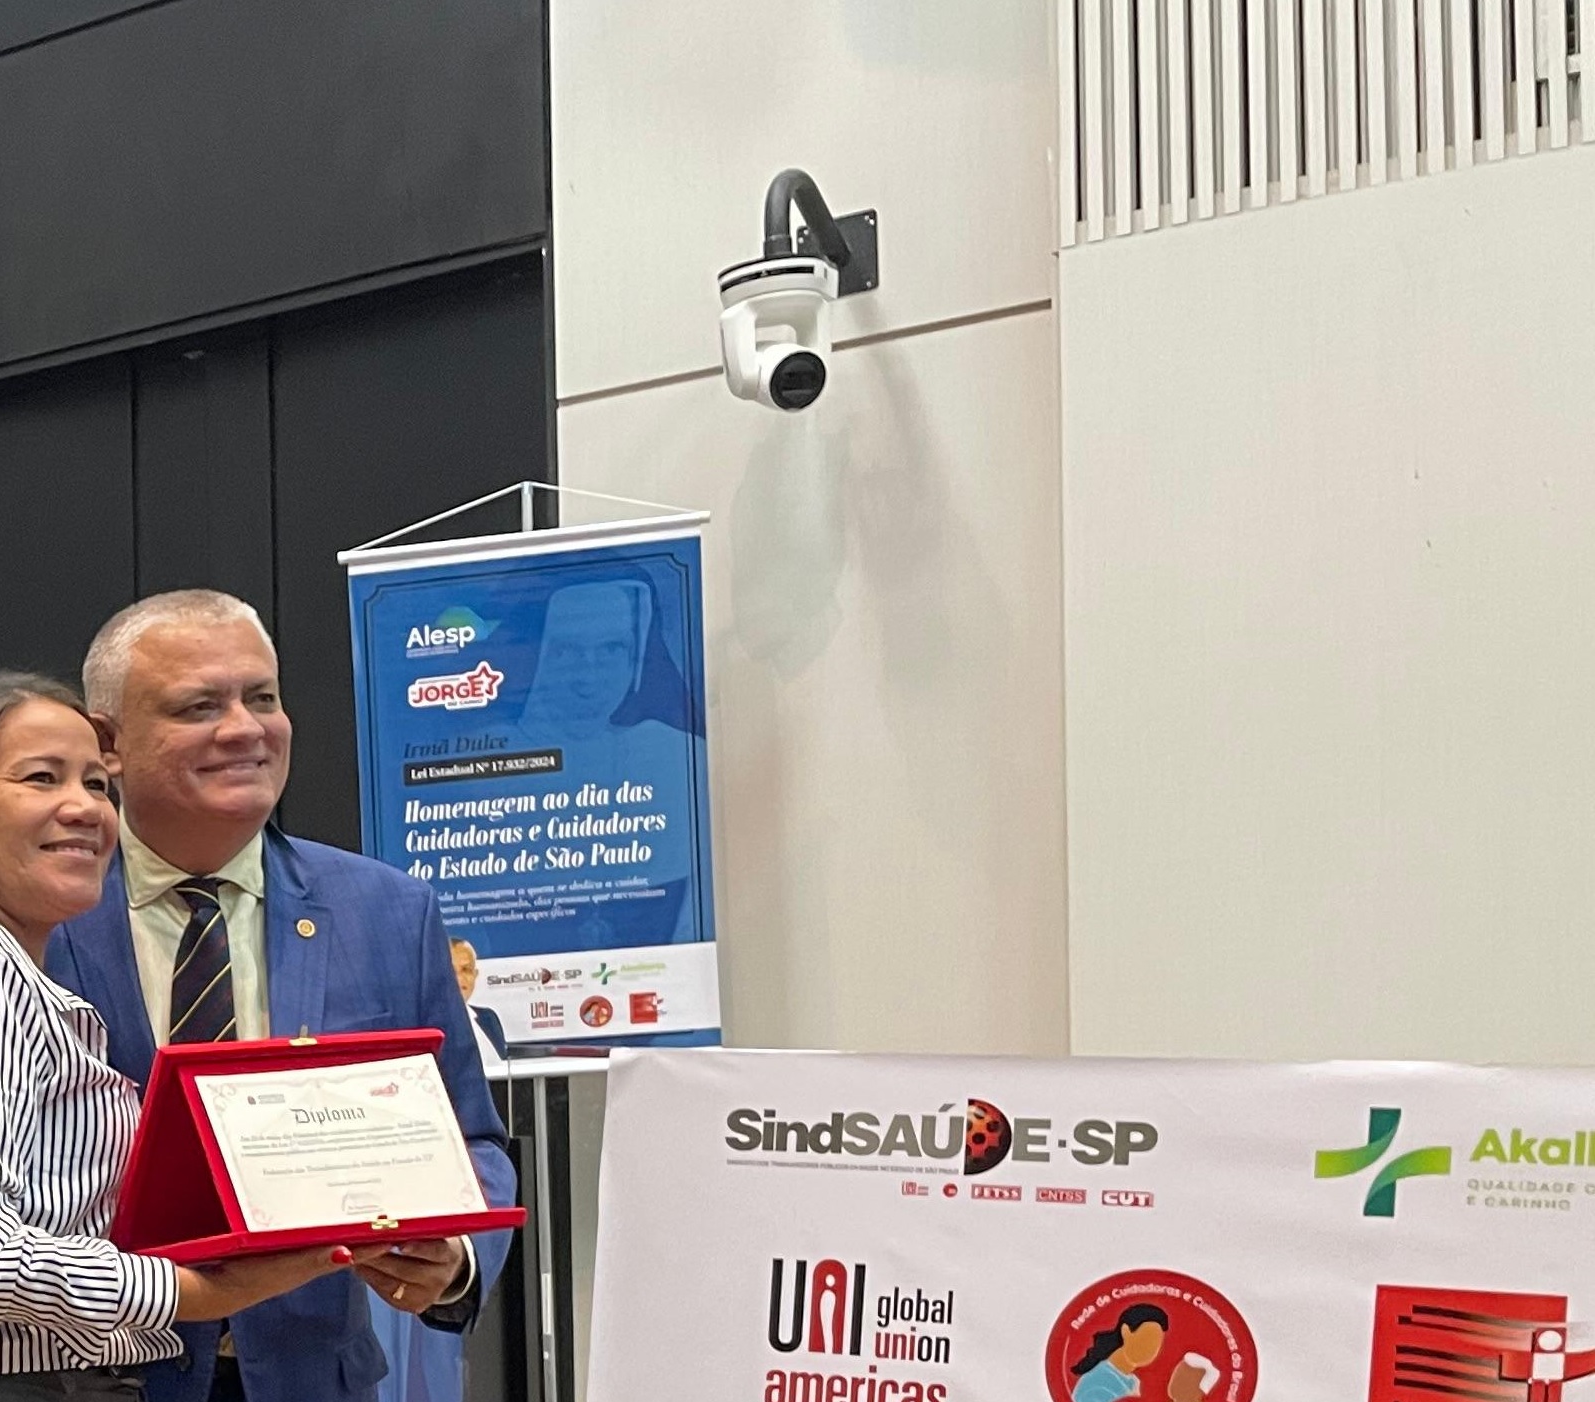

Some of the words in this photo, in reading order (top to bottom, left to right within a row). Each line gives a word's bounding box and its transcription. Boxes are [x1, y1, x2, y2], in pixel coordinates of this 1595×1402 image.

[406, 625, 476, 649] Alesp
[412, 680, 486, 704] JORGE
[403, 738, 450, 760] Irmã
[456, 732, 509, 753] Dulce
[411, 767, 427, 781] Lei
[429, 762, 475, 779] Estadual
[405, 793, 537, 823] Homenagem
[543, 792, 569, 810] ao
[576, 783, 609, 807] dia
[615, 780, 654, 804] das
[406, 818, 523, 853] Cuidadoras
[529, 825, 542, 842] e
[546, 811, 667, 840] Cuidadores
[407, 857, 434, 882] do
[439, 850, 508, 880] Estado
[513, 847, 540, 872] de
[544, 843, 585, 870] São
[590, 840, 652, 867] Paulo
[291, 1106, 366, 1125] Diploma
[1467, 1178, 1576, 1194] QUALIDADE
[1103, 1191, 1150, 1206] CUT
[1467, 1195, 1476, 1206] E
[1484, 1196, 1572, 1211] CARINHO
[877, 1286, 954, 1328] global
[1096, 1294, 1111, 1308] de
[1112, 1283, 1182, 1299] Cuidadoras
[1182, 1292, 1192, 1301] e
[875, 1326, 951, 1364] union
